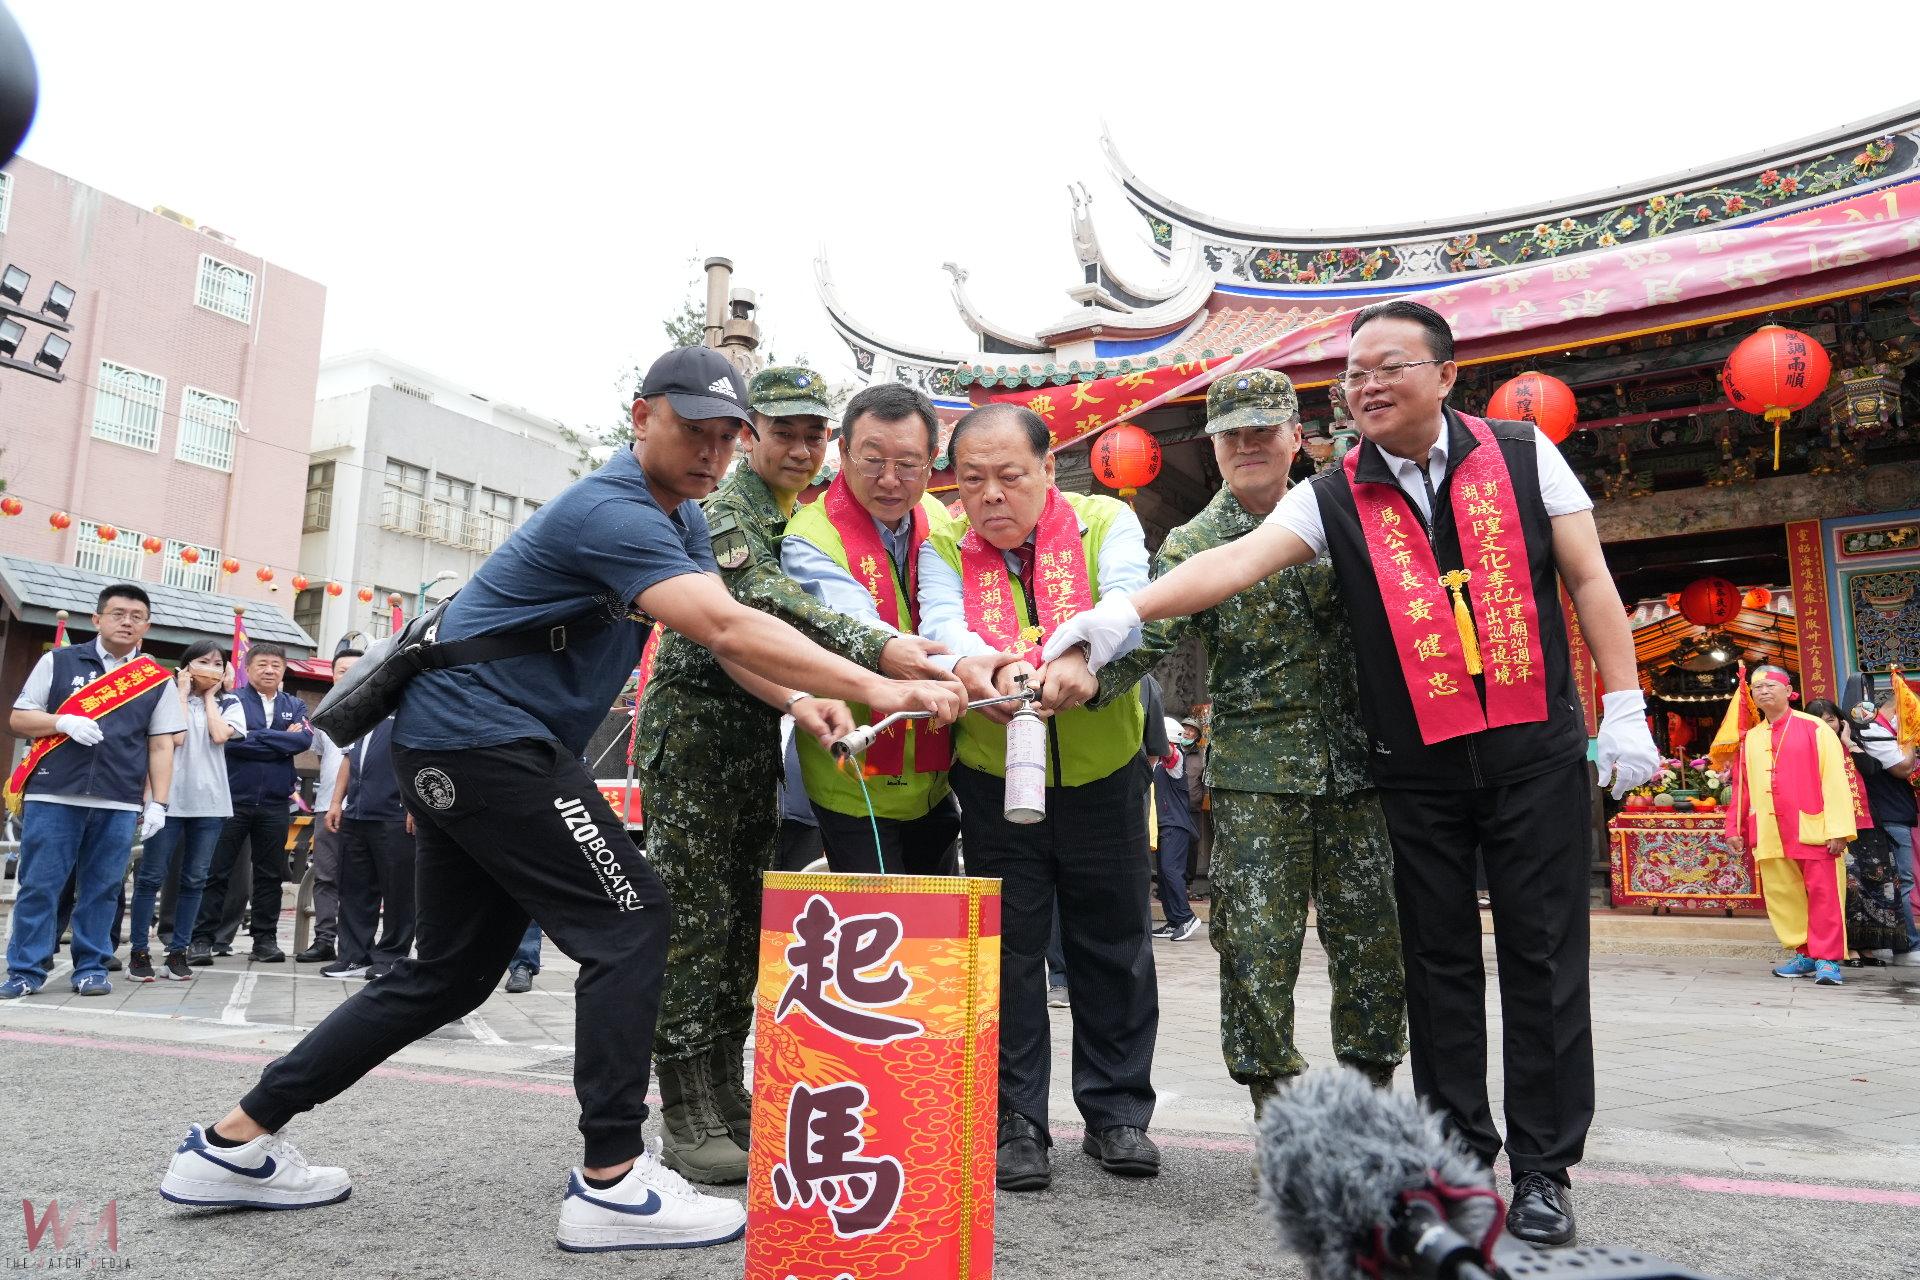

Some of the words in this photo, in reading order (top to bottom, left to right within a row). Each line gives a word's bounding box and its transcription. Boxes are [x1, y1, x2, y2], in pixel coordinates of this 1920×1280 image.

[1785, 333, 1806, 388] 風調雨順
[554, 797, 599, 843] JIZO
[772, 894, 925, 1280] 起馬
